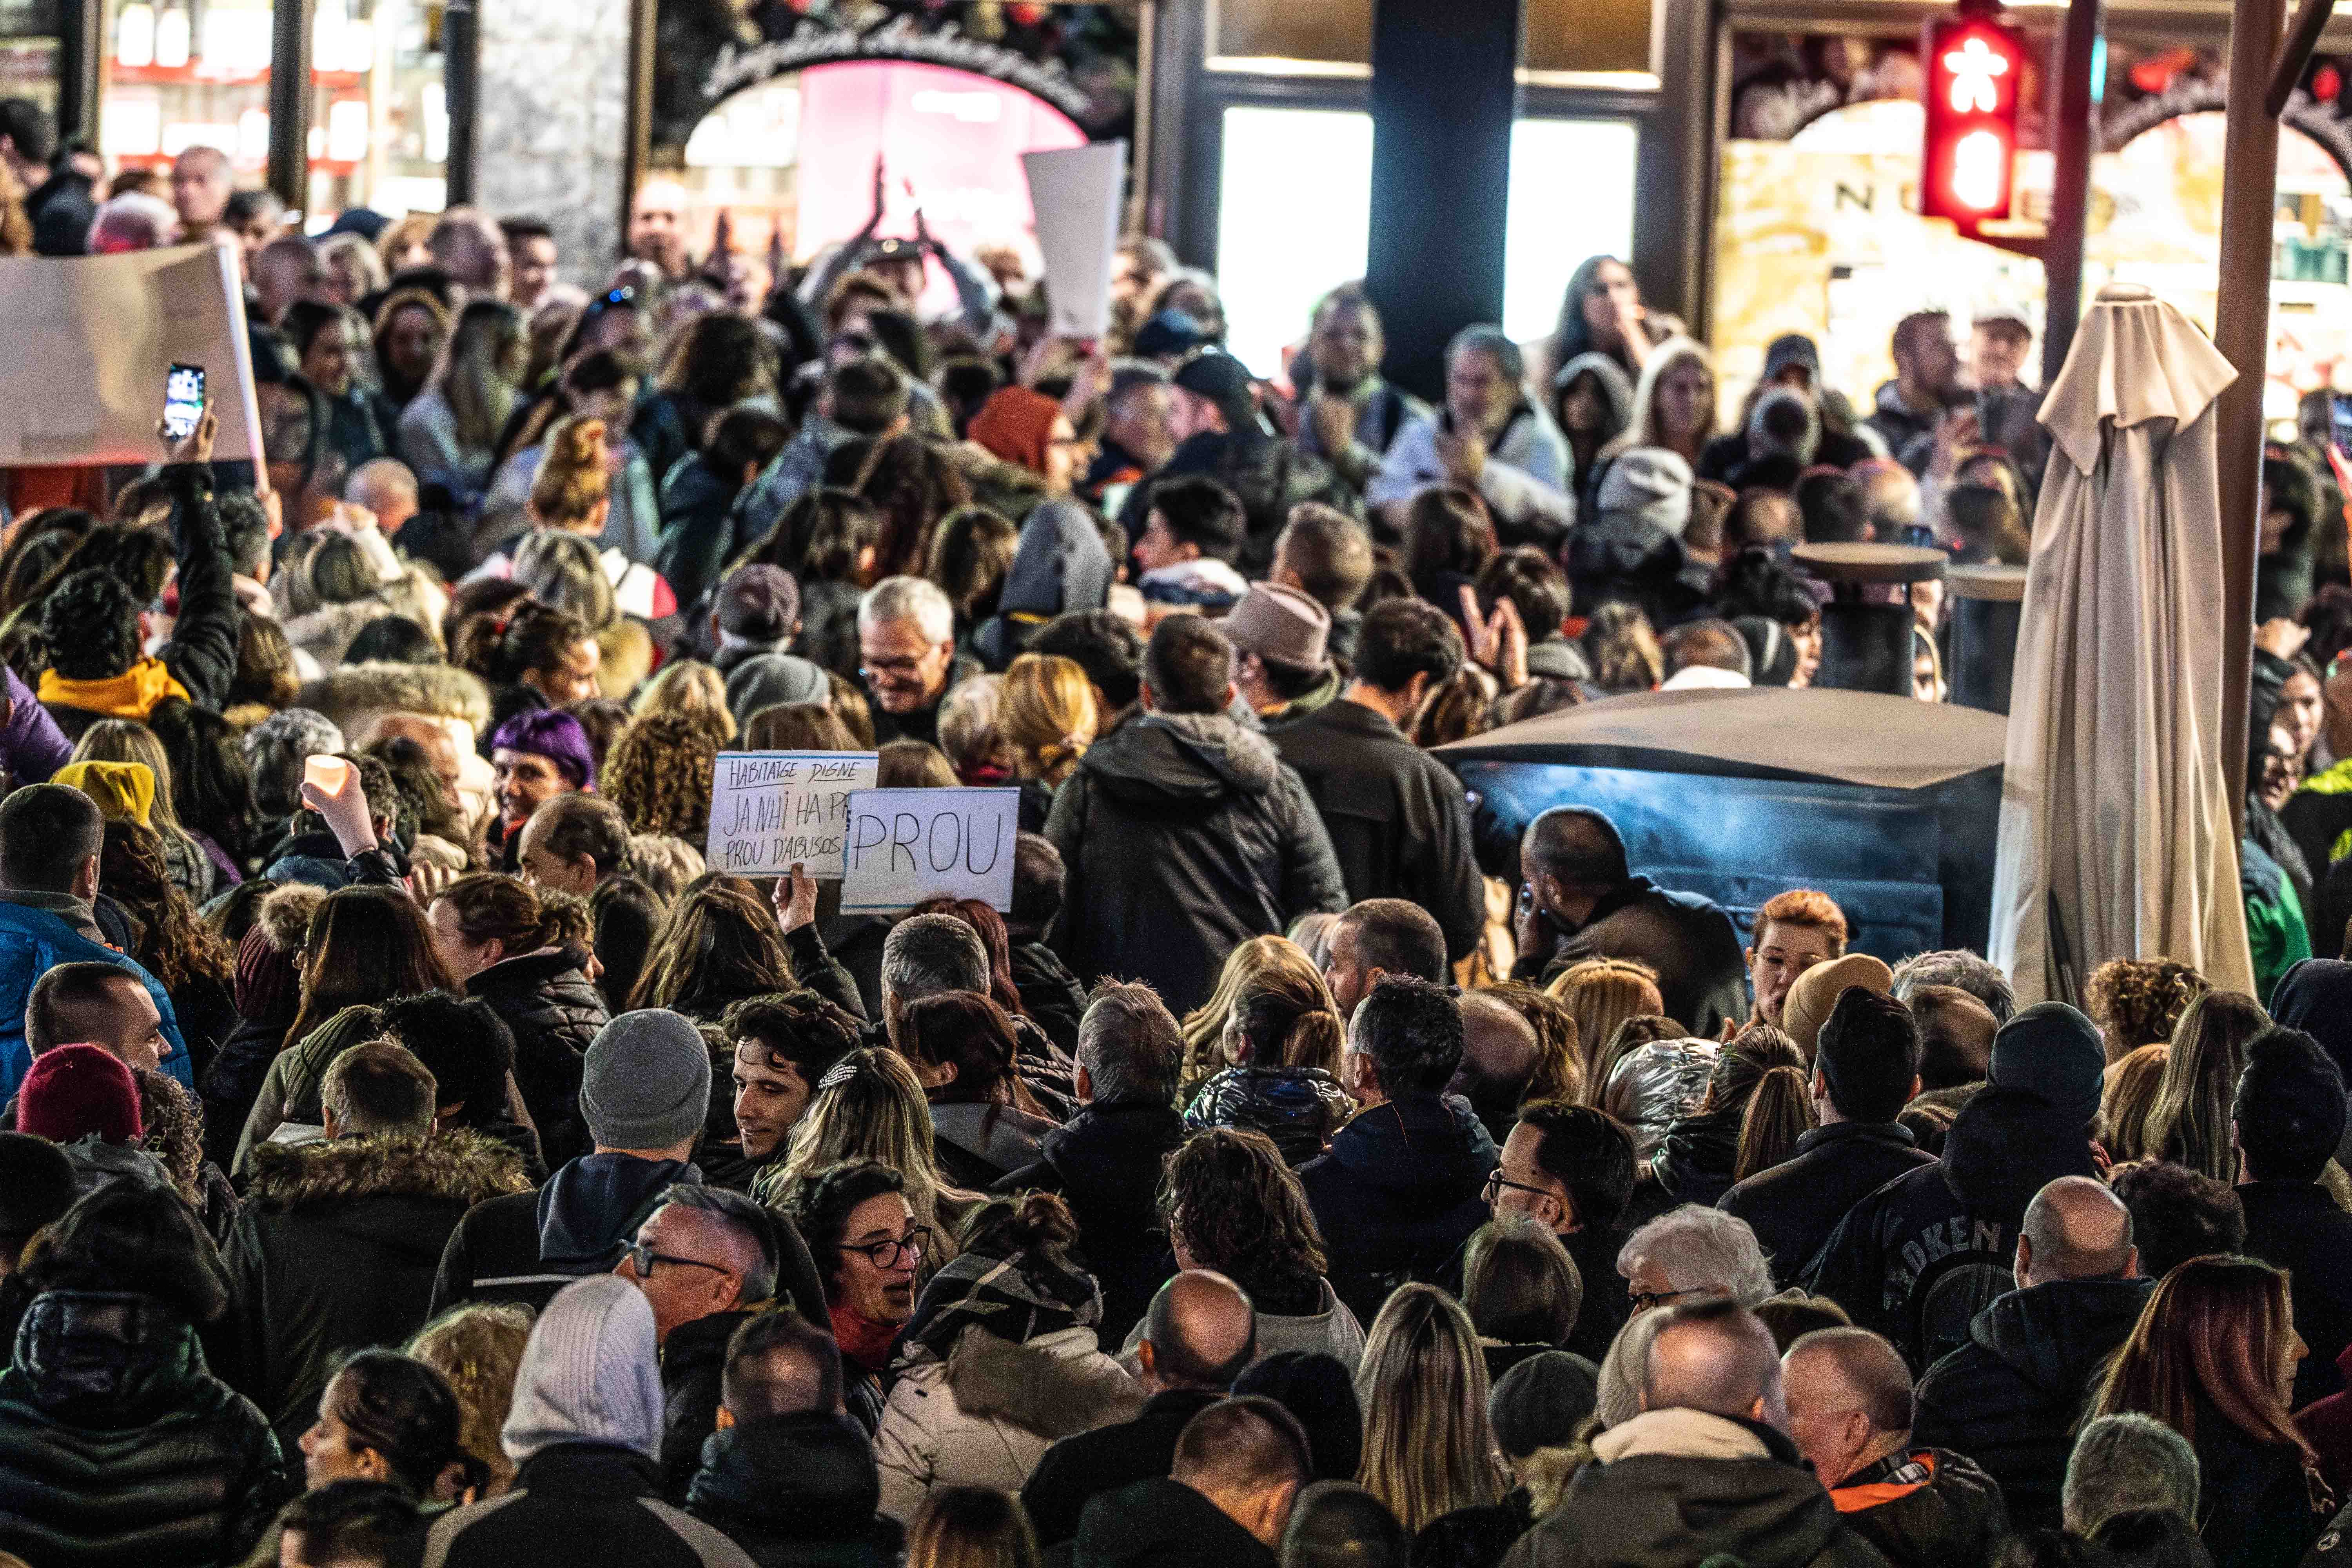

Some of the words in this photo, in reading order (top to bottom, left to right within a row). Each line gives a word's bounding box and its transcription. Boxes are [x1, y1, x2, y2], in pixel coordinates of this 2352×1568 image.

[730, 760, 798, 786] HABITATGE
[808, 760, 860, 784] DIGNE
[723, 793, 750, 837] JA
[796, 792, 821, 826] HA
[725, 839, 764, 869] PROU
[853, 812, 1001, 874] PROU
